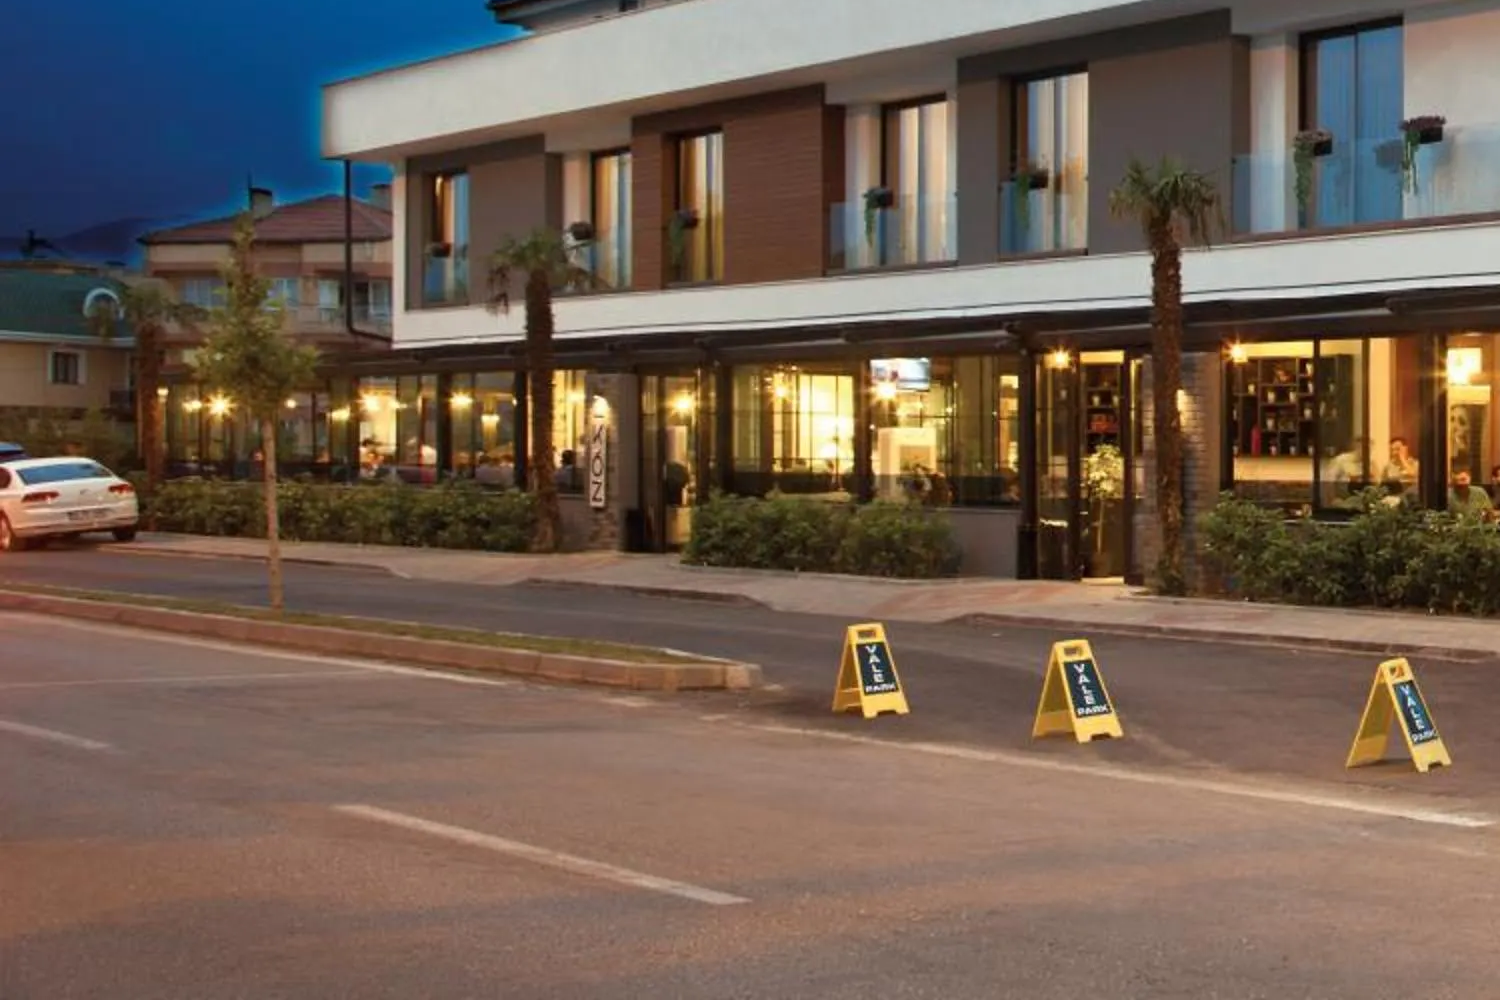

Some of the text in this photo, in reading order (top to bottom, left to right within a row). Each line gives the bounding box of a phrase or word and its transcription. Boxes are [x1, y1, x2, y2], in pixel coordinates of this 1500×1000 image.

[865, 643, 885, 683] VALE
[866, 682, 896, 693] PARK
[1073, 663, 1097, 705] VALE
[1077, 703, 1109, 716] PARK
